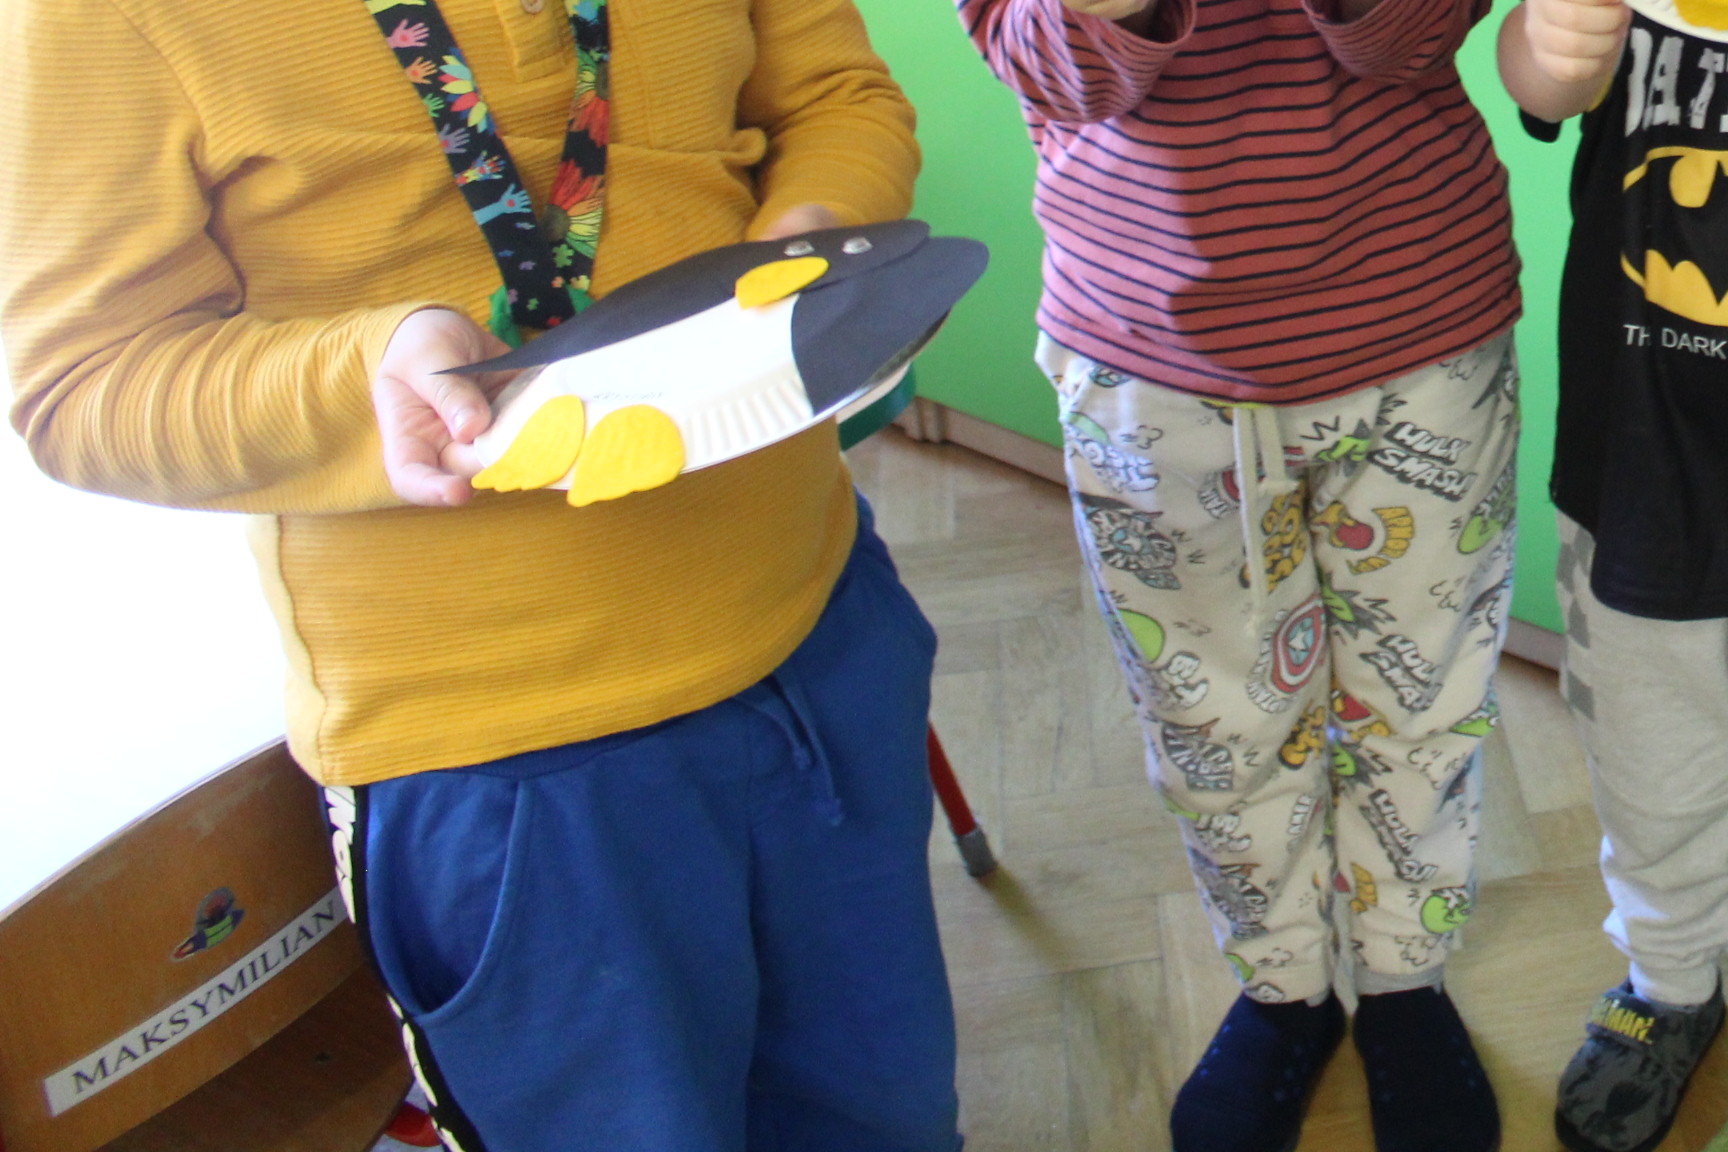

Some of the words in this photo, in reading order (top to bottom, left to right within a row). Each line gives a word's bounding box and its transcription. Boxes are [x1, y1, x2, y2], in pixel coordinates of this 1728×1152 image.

[1623, 323, 1651, 347] TH
[1660, 327, 1728, 360] DARK
[1387, 422, 1472, 464] HULK
[1369, 448, 1478, 501] SMASH
[71, 899, 338, 1097] MAKSYMILIAN
